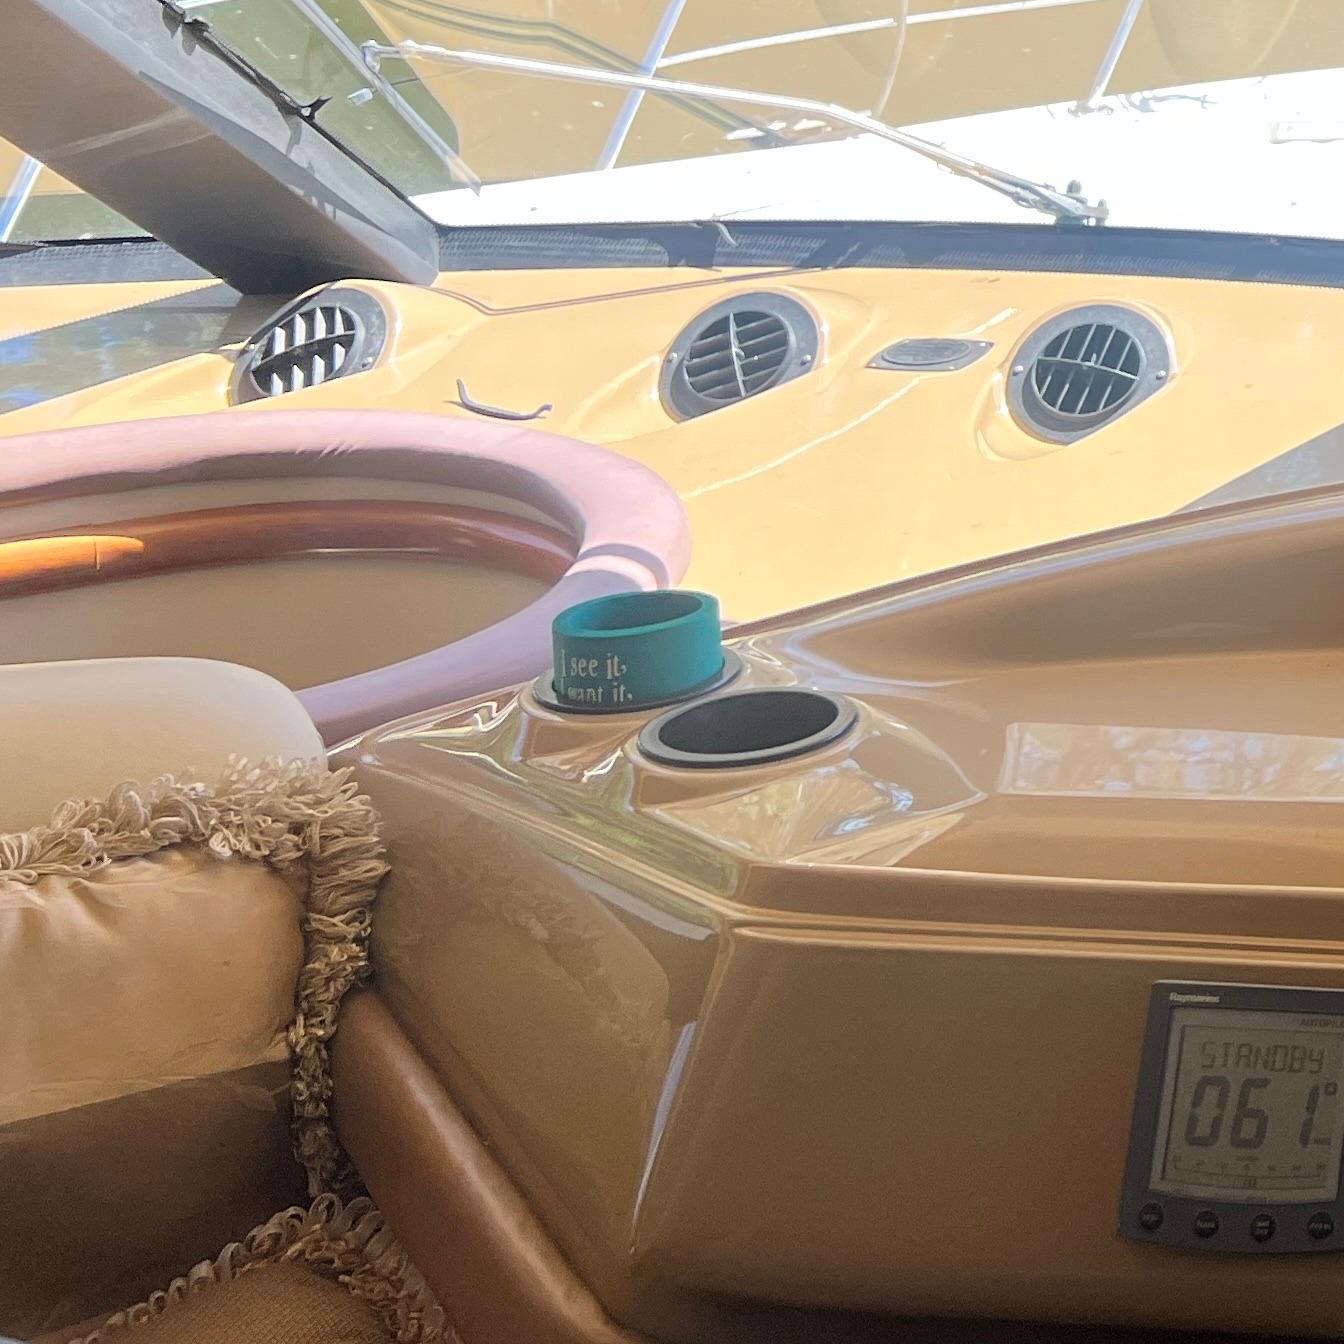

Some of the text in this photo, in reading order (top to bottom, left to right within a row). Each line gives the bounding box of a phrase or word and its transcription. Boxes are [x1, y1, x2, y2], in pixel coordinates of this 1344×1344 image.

[570, 657, 599, 678] see
[606, 652, 628, 680] it,
[568, 686, 604, 703] want
[612, 682, 633, 703] it,
[1201, 1041, 1325, 1074] STANDBY
